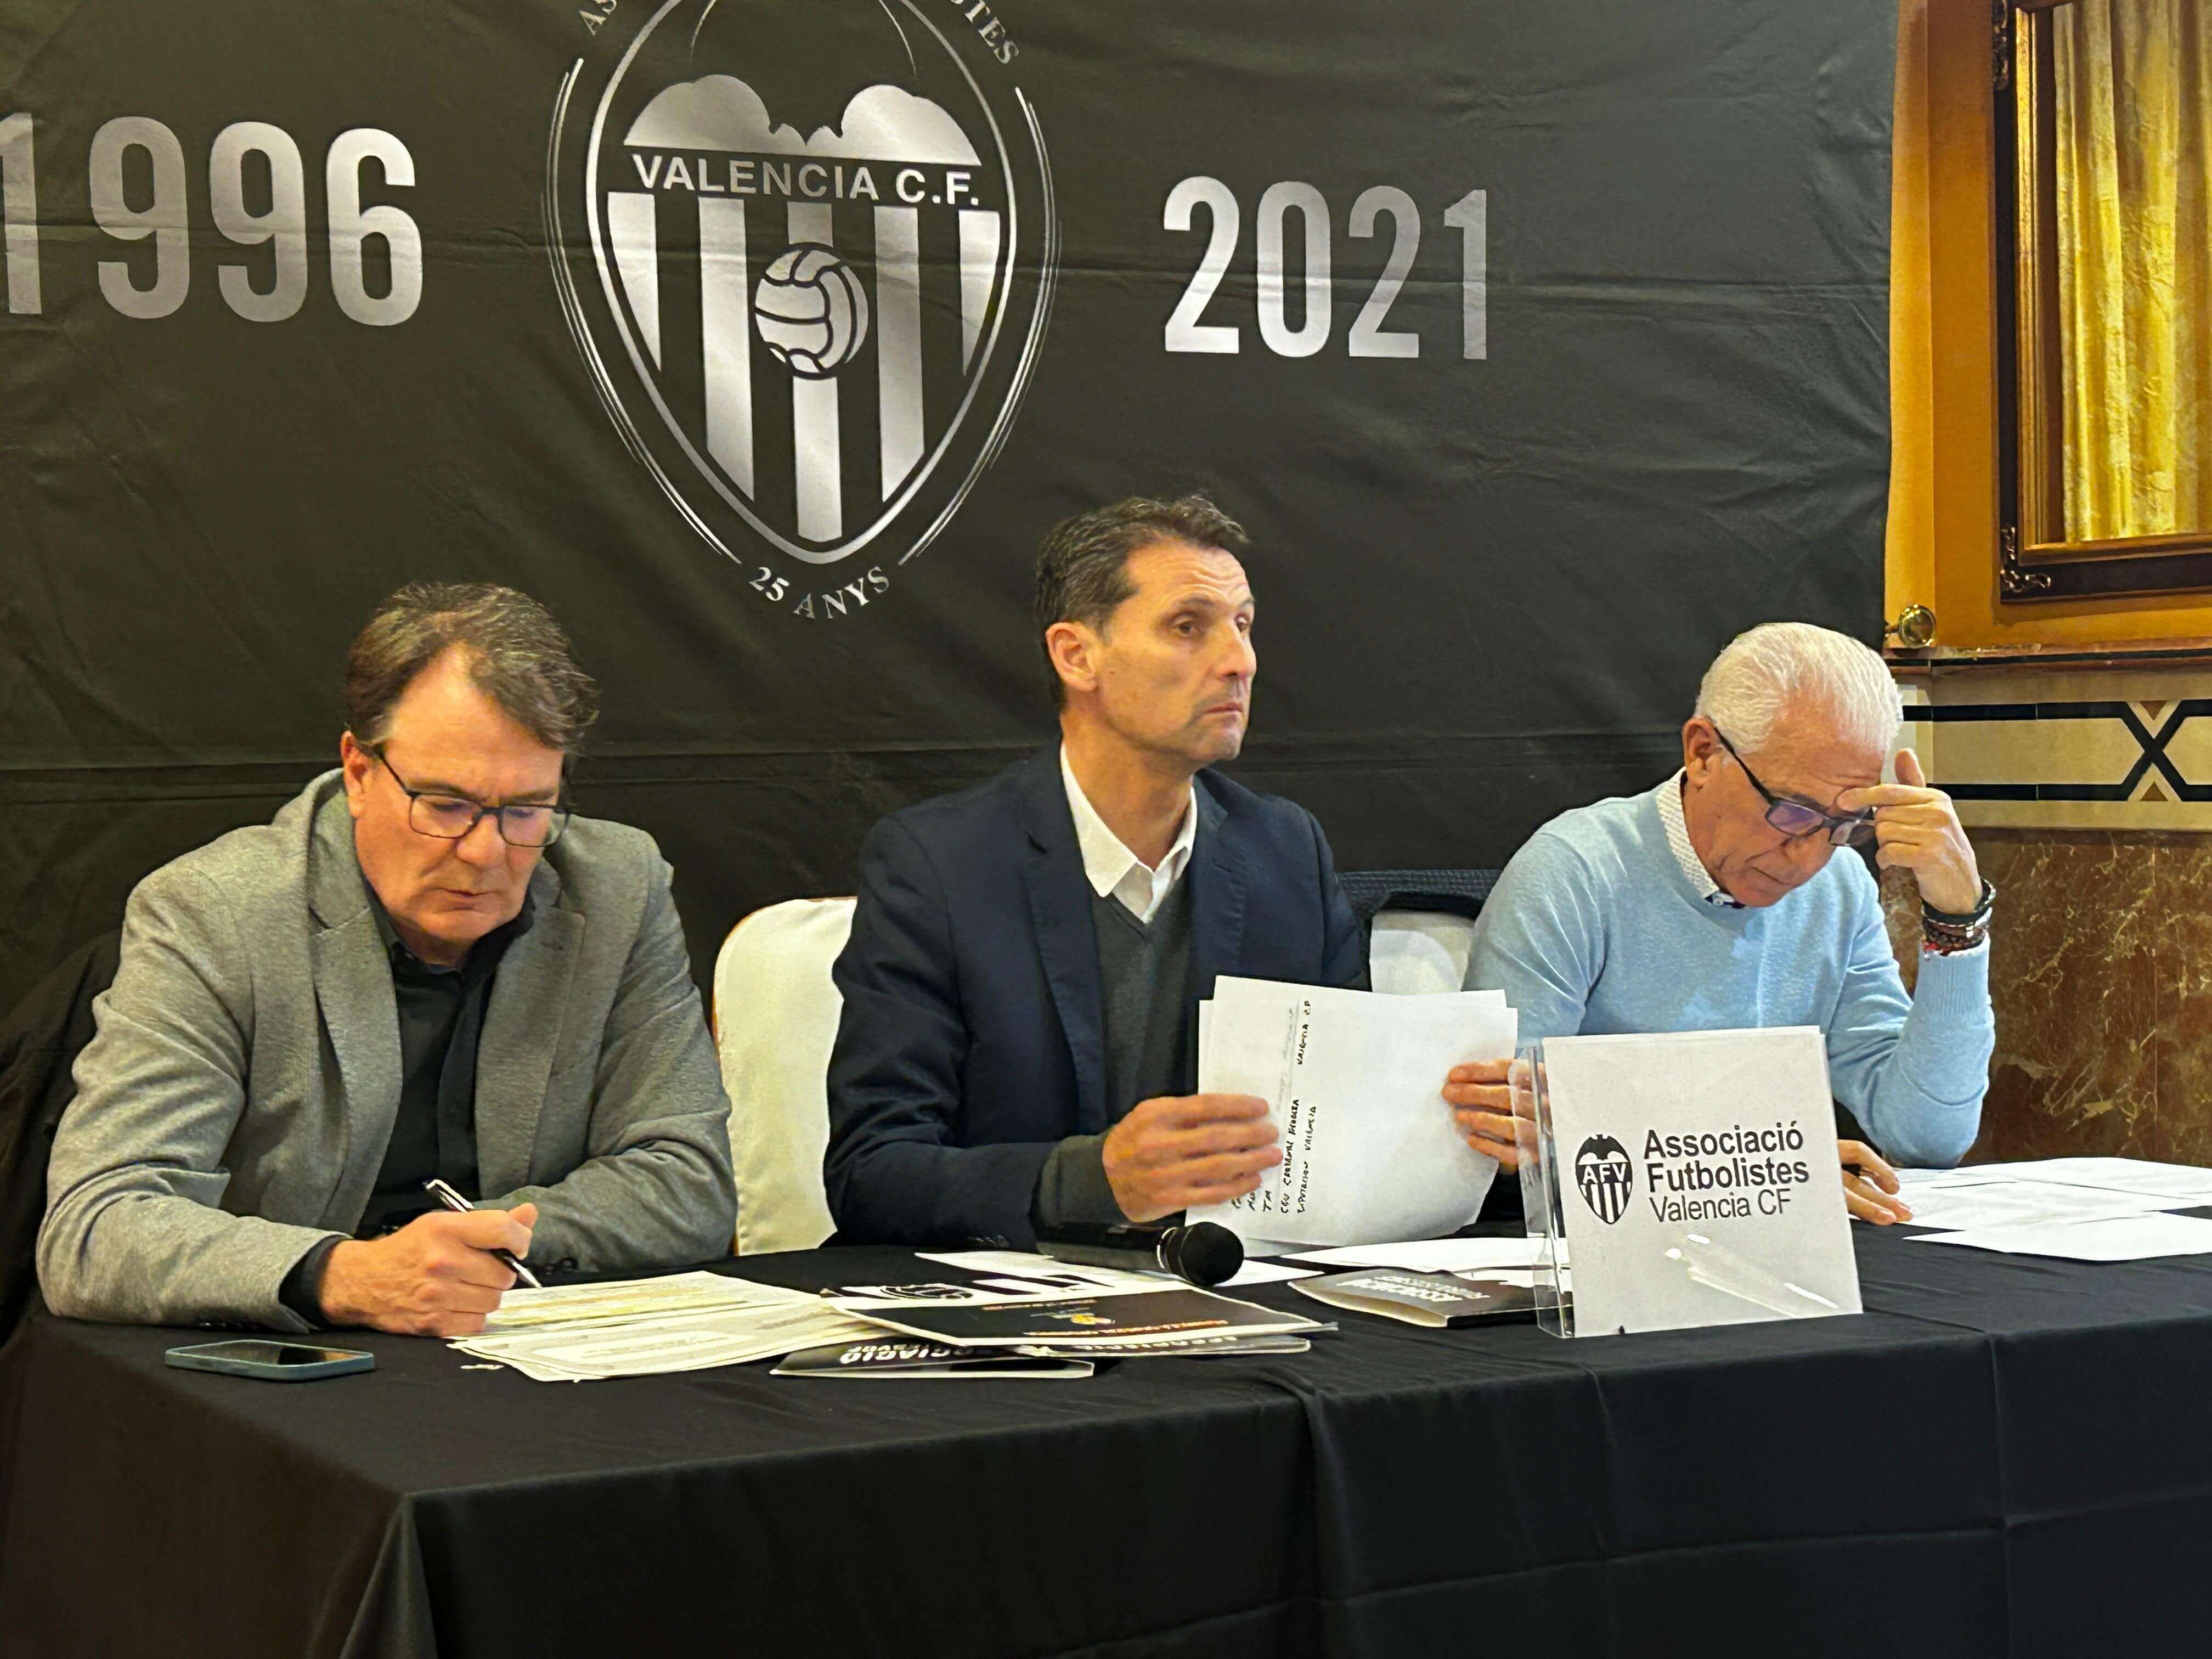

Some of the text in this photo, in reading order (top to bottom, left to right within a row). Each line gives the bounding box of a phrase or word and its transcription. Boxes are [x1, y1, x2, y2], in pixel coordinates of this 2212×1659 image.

[631, 153, 979, 206] VALENCIA C.F.
[0, 112, 423, 326] 1996
[1164, 176, 1487, 360] 2021
[748, 566, 890, 619] 25 ANYS
[1643, 1121, 1804, 1159] Associació
[1583, 1164, 1626, 1184] AFV
[1646, 1157, 1809, 1193] Futbolistes
[1649, 1188, 1791, 1222] Valencia CF
